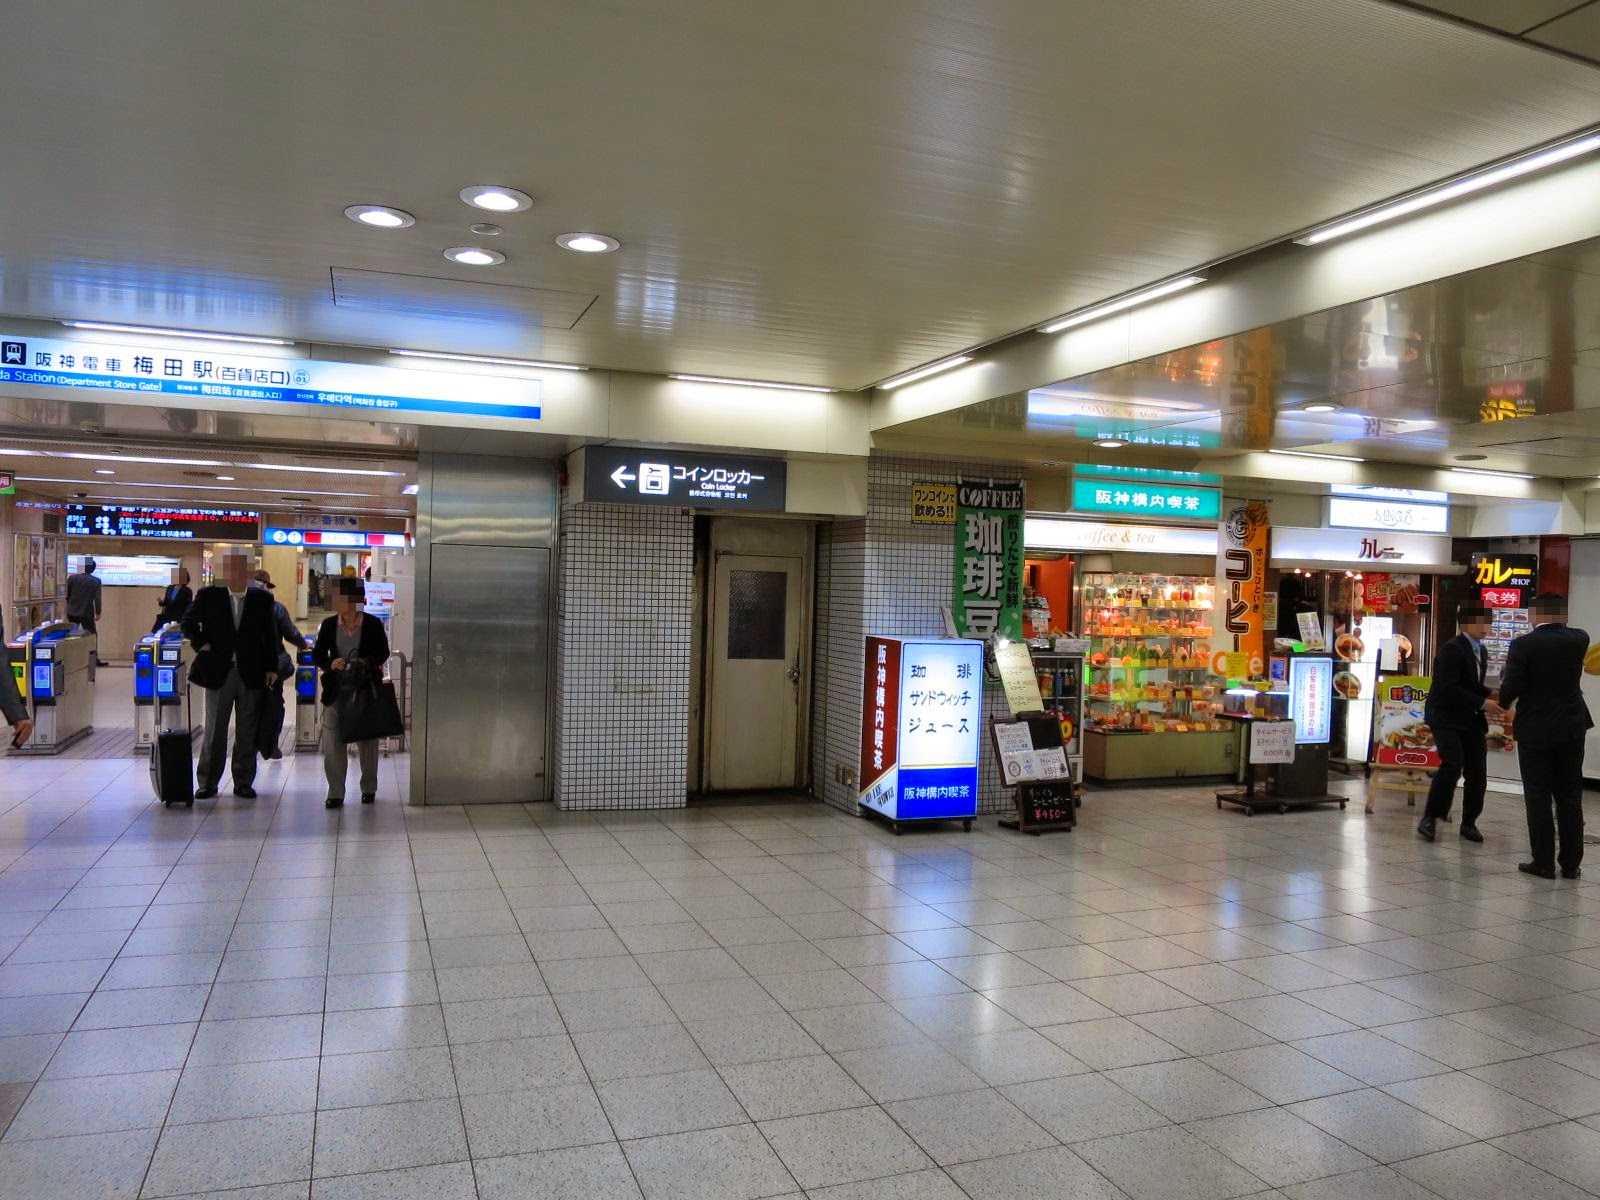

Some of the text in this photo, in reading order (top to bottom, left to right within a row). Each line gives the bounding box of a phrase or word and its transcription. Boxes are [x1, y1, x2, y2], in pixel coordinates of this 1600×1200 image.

[35, 352, 122, 372] 阪神電車
[14, 370, 56, 383] Station
[56, 376, 112, 388] (Department
[113, 379, 138, 390] Store
[139, 380, 163, 392] Gate)
[672, 466, 766, 485] コインロッカー
[701, 482, 737, 491] Coin Locker
[914, 489, 955, 503] ワンコインで
[960, 487, 1021, 509] COFFEE
[1095, 489, 1201, 511] 阪神構内喫茶
[914, 504, 954, 519] 飲める!!
[1076, 528, 1156, 544] coffee & tea
[1359, 538, 1395, 558] カレー
[962, 512, 1005, 639] 珈琲豆
[1475, 557, 1532, 585] カレー
[1510, 577, 1531, 586] SHOP
[1225, 548, 1253, 653] コーヒー
[910, 664, 973, 679] 珈琲
[873, 644, 887, 770] 阪神構内喫茶
[909, 690, 972, 707] サンドウィッチ
[908, 717, 970, 734] ジュース
[903, 785, 970, 800] 阪神構内喫茶
